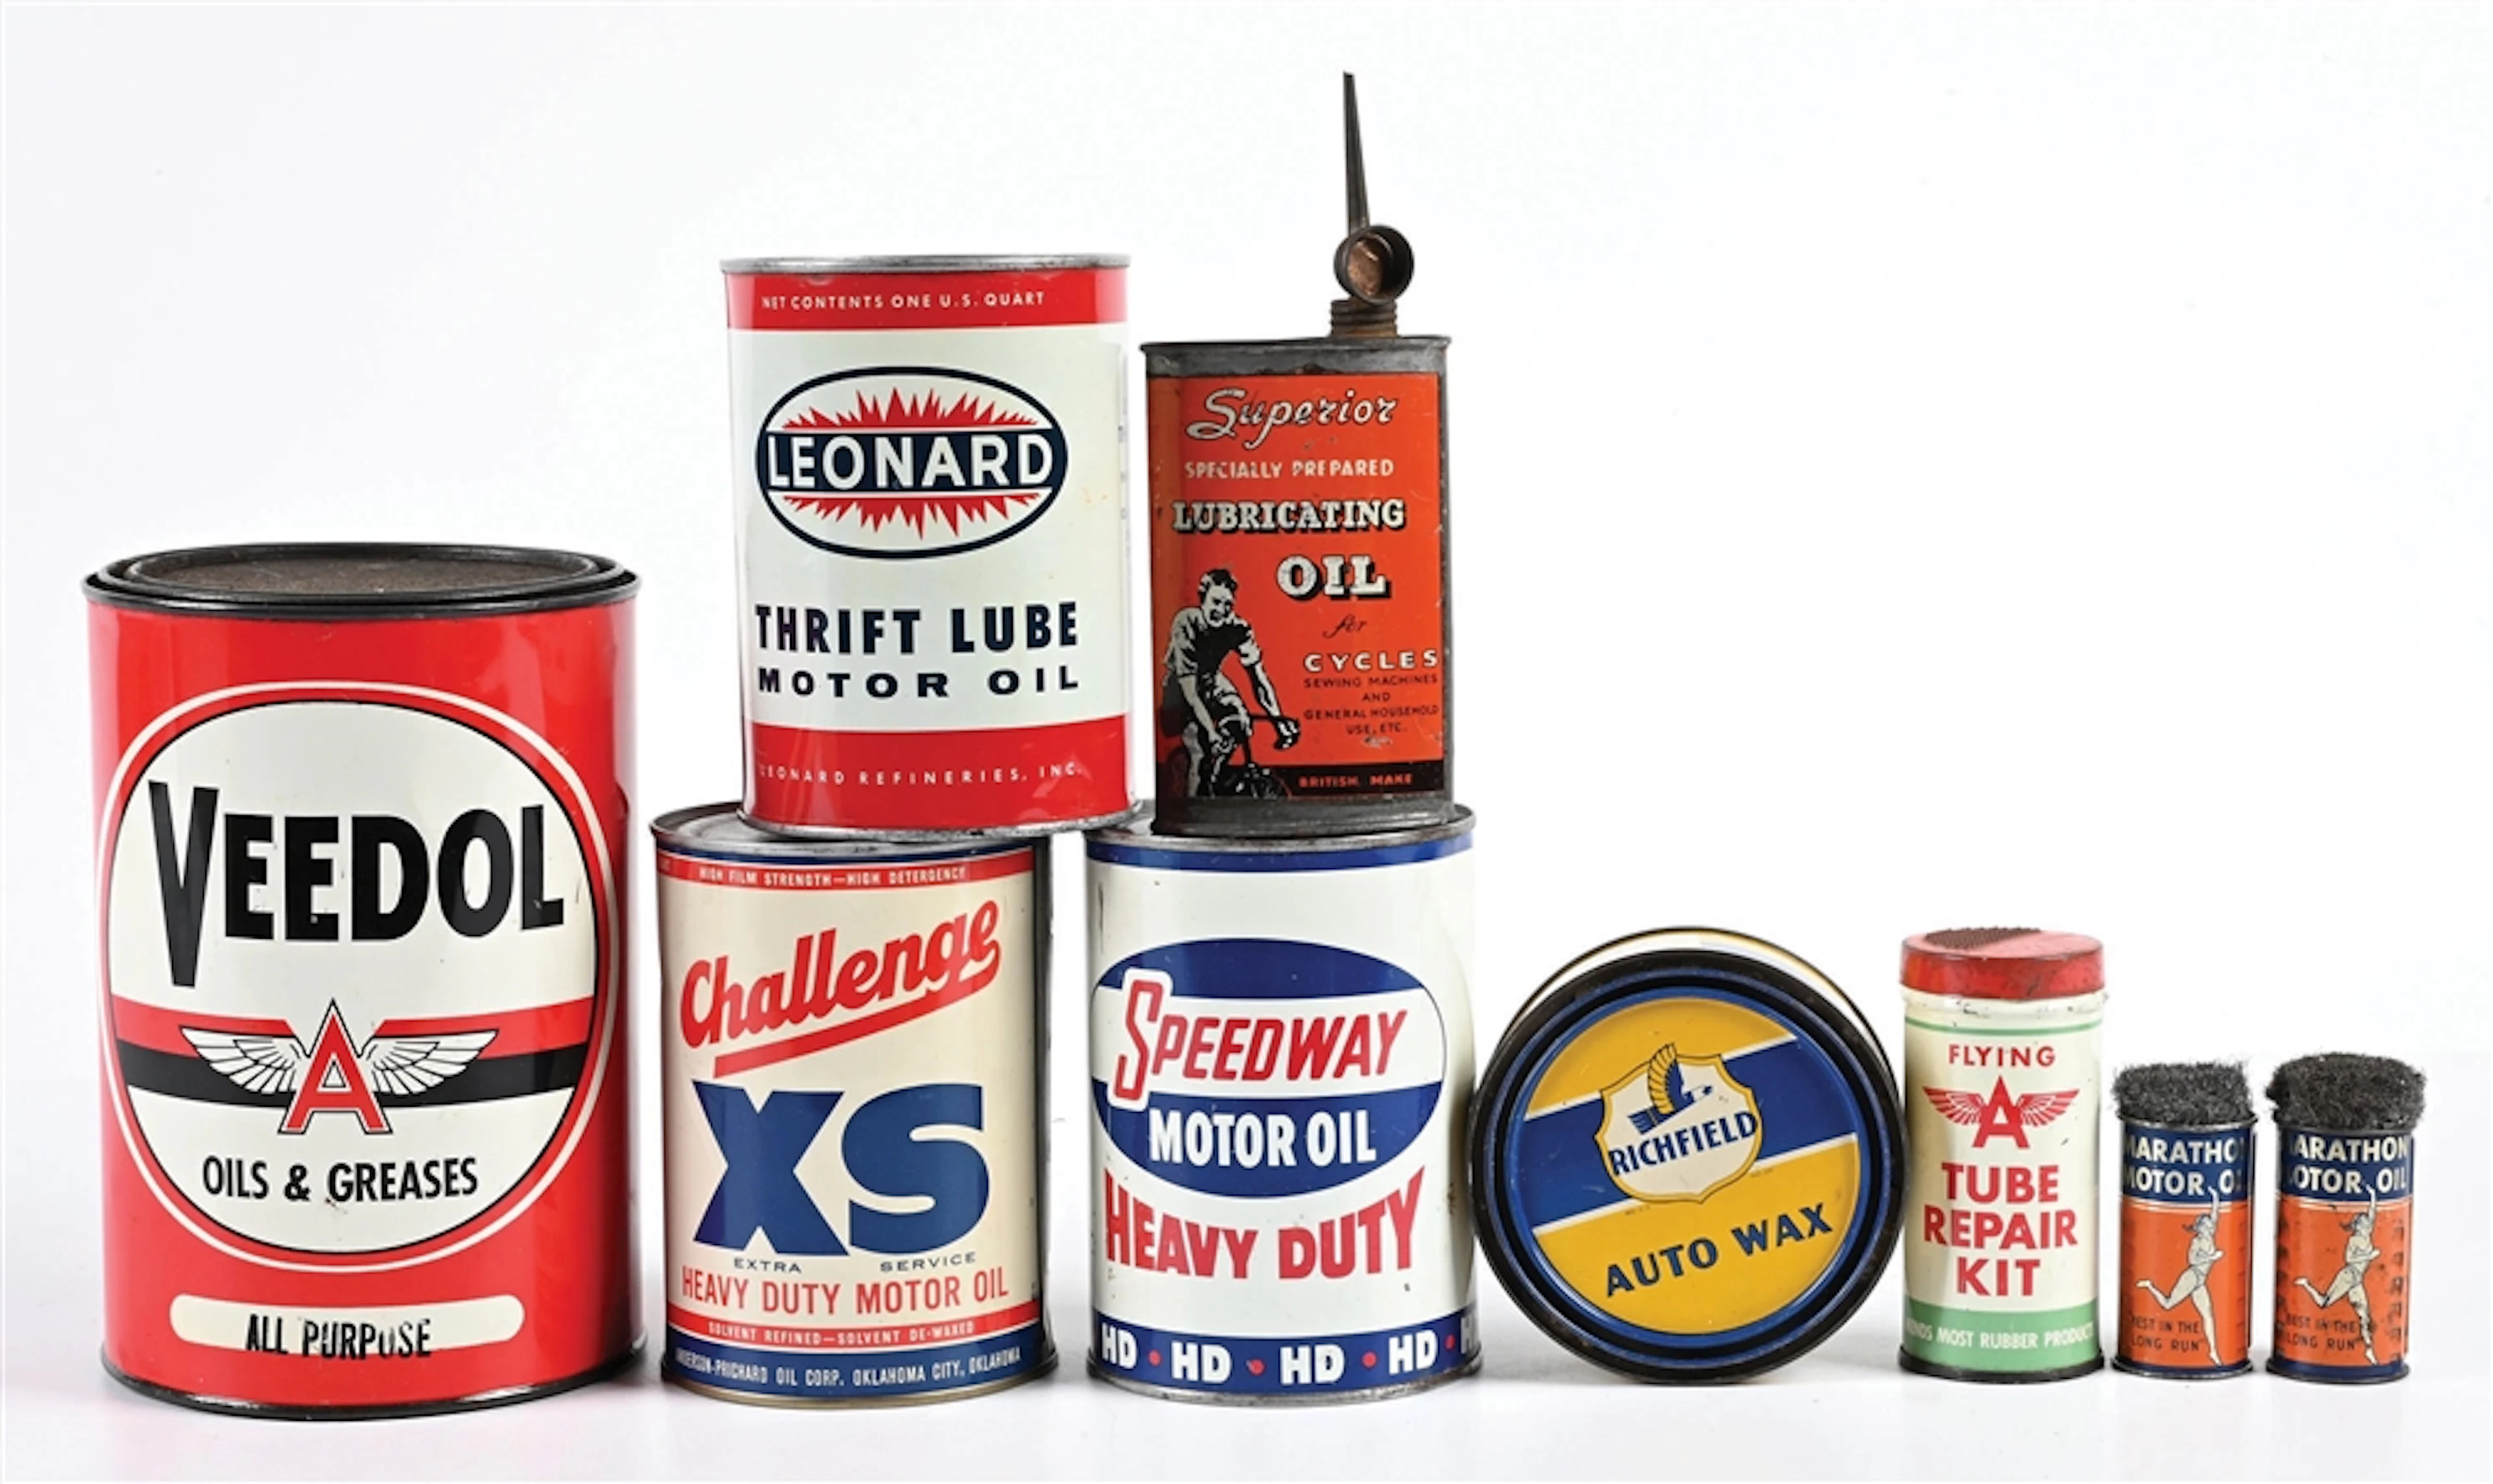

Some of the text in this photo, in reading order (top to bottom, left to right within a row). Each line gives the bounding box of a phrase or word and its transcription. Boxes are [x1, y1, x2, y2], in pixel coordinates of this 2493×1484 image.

[762, 291, 1045, 310] NET CONTENTS ONE U.S. QUART
[1186, 388, 1398, 449] Superior
[767, 434, 1054, 490] LEONARD
[1185, 459, 1395, 478] SPECIALLY PREPARED
[1172, 498, 1408, 534] LUBRICATING
[1276, 554, 1391, 601] OIL
[755, 601, 1078, 654] THRIFT LUBE
[1322, 614, 1367, 638] for
[1303, 649, 1439, 673] CYCLES
[758, 665, 1078, 698] MOTOR OIL
[1304, 673, 1438, 689] SEWING MACHINES
[1361, 692, 1391, 702] AND
[1303, 704, 1439, 721] GENERAL HOUSEHOLD
[1346, 723, 1376, 736] USE,
[1039, 760, 1083, 779] INC.
[1298, 773, 1413, 789] BRITISH MAKE
[148, 779, 565, 989] VEEDOL
[699, 866, 724, 882] HIGH
[728, 869, 758, 884] FILM
[888, 865, 967, 885] DETERGENCY
[680, 900, 1001, 1050] Challenge
[1113, 978, 1408, 1102] SPEEDWAY
[1948, 1044, 2057, 1067] FLYING
[278, 998, 393, 1135] A
[1972, 1074, 2030, 1150] A
[1148, 1107, 1377, 1169] MOTOR OIL
[1608, 1110, 1758, 1176] RICHFIELD
[2292, 1133, 2409, 1163] ARATHON
[202, 1156, 478, 1202] OILS & GREASES
[692, 1079, 990, 1257] XS
[1941, 1162, 2060, 1206] TUBE
[2292, 1163, 2363, 1194] OTOR
[1104, 1164, 1426, 1281] HEAVY DUTY
[1923, 1204, 2079, 1250] REPAIR
[734, 1252, 976, 1274] EXTRA SERVICE
[1605, 1202, 1833, 1298] AUTO WAX
[682, 1264, 1010, 1316] HEAVY DUTY MOTOR OIL
[1956, 1257, 2041, 1297] KIT
[246, 1313, 432, 1360] ALL PURPOSE
[708, 1320, 758, 1342] SOLVENT
[1935, 1326, 1975, 1348] MOST
[1979, 1331, 2039, 1350] RUBBER
[2132, 1335, 2163, 1350] LONG
[2159, 1320, 2172, 1331] IN
[2177, 1320, 2200, 1334] THE
[2287, 1331, 2318, 1349] LONG
[2315, 1318, 2329, 1331] IN
[2334, 1320, 2356, 1333] THE
[775, 1367, 798, 1387] OIL
[804, 1368, 845, 1387] CORP.
[852, 1364, 926, 1387] OKLAHOMA
[931, 1359, 965, 1381] CITY,
[968, 1345, 1021, 1374] OKLAHOMA
[1102, 1322, 1138, 1370] HD
[1171, 1341, 1233, 1384] HD
[1280, 1344, 1346, 1385] HD
[1387, 1328, 1439, 1374] HD
